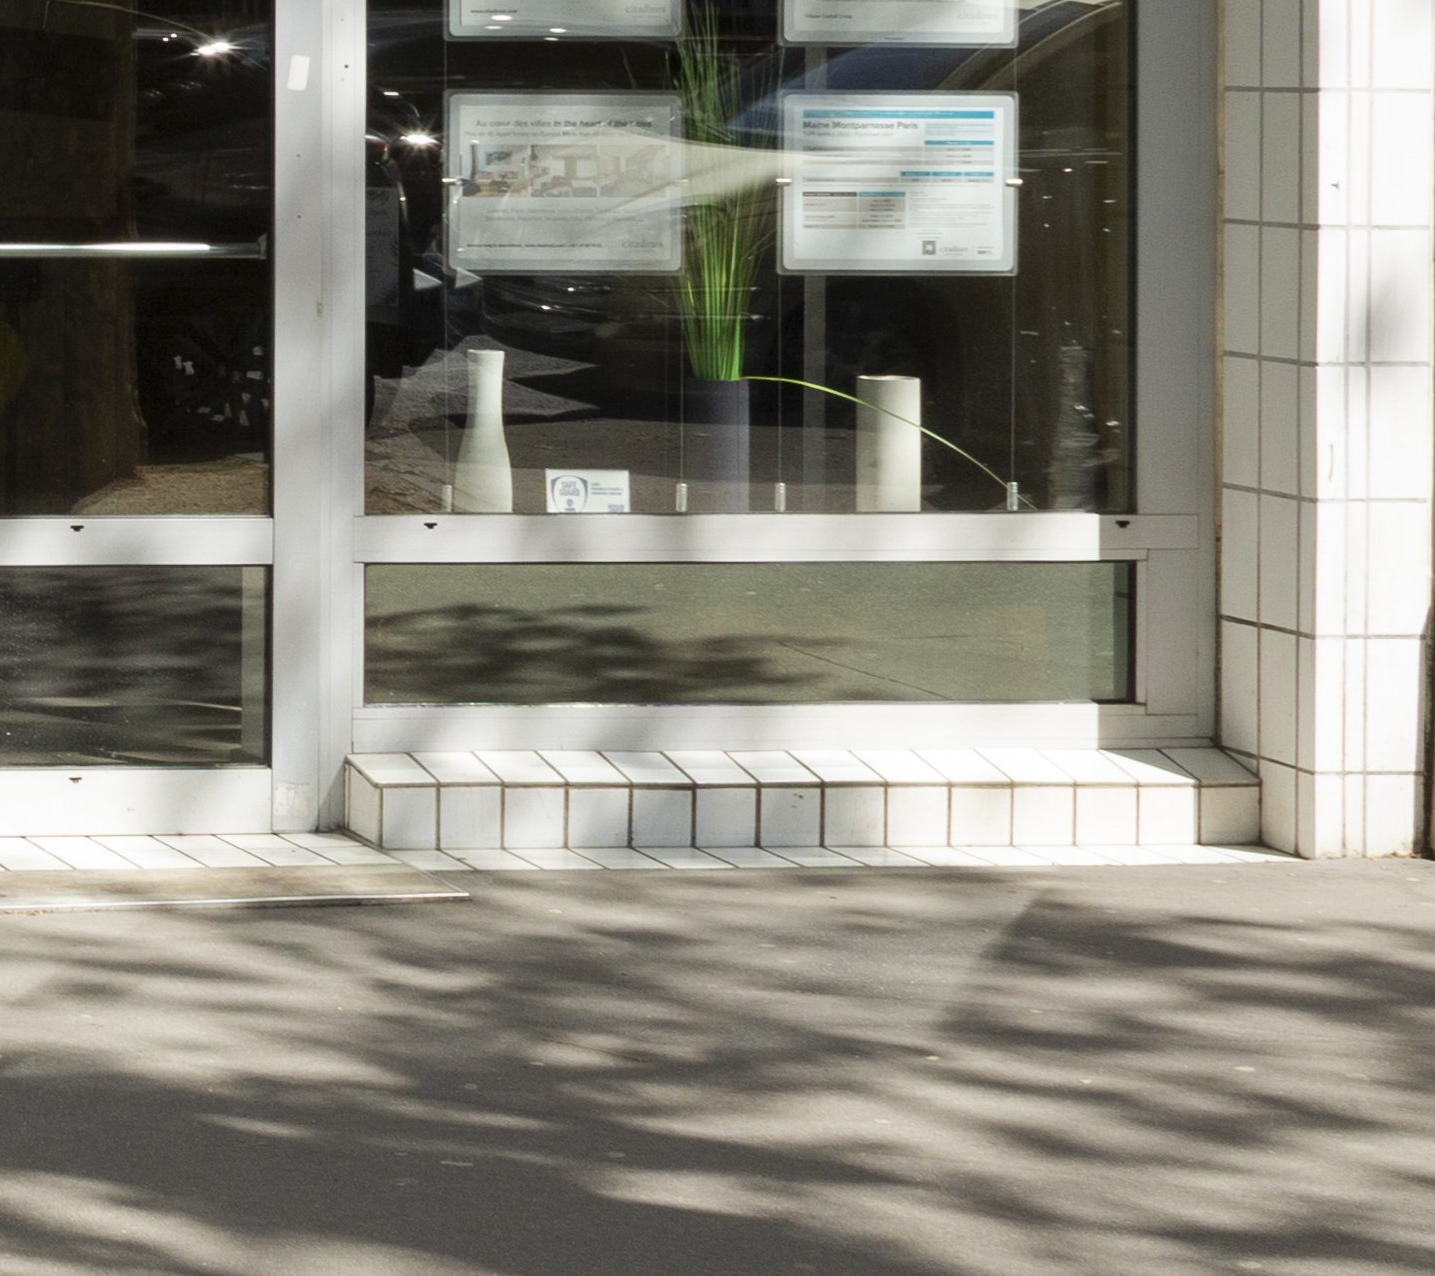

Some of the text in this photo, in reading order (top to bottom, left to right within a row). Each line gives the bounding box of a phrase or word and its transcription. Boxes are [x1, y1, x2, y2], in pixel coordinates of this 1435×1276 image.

[803, 121, 918, 131] Maine Montparnasse Paris
